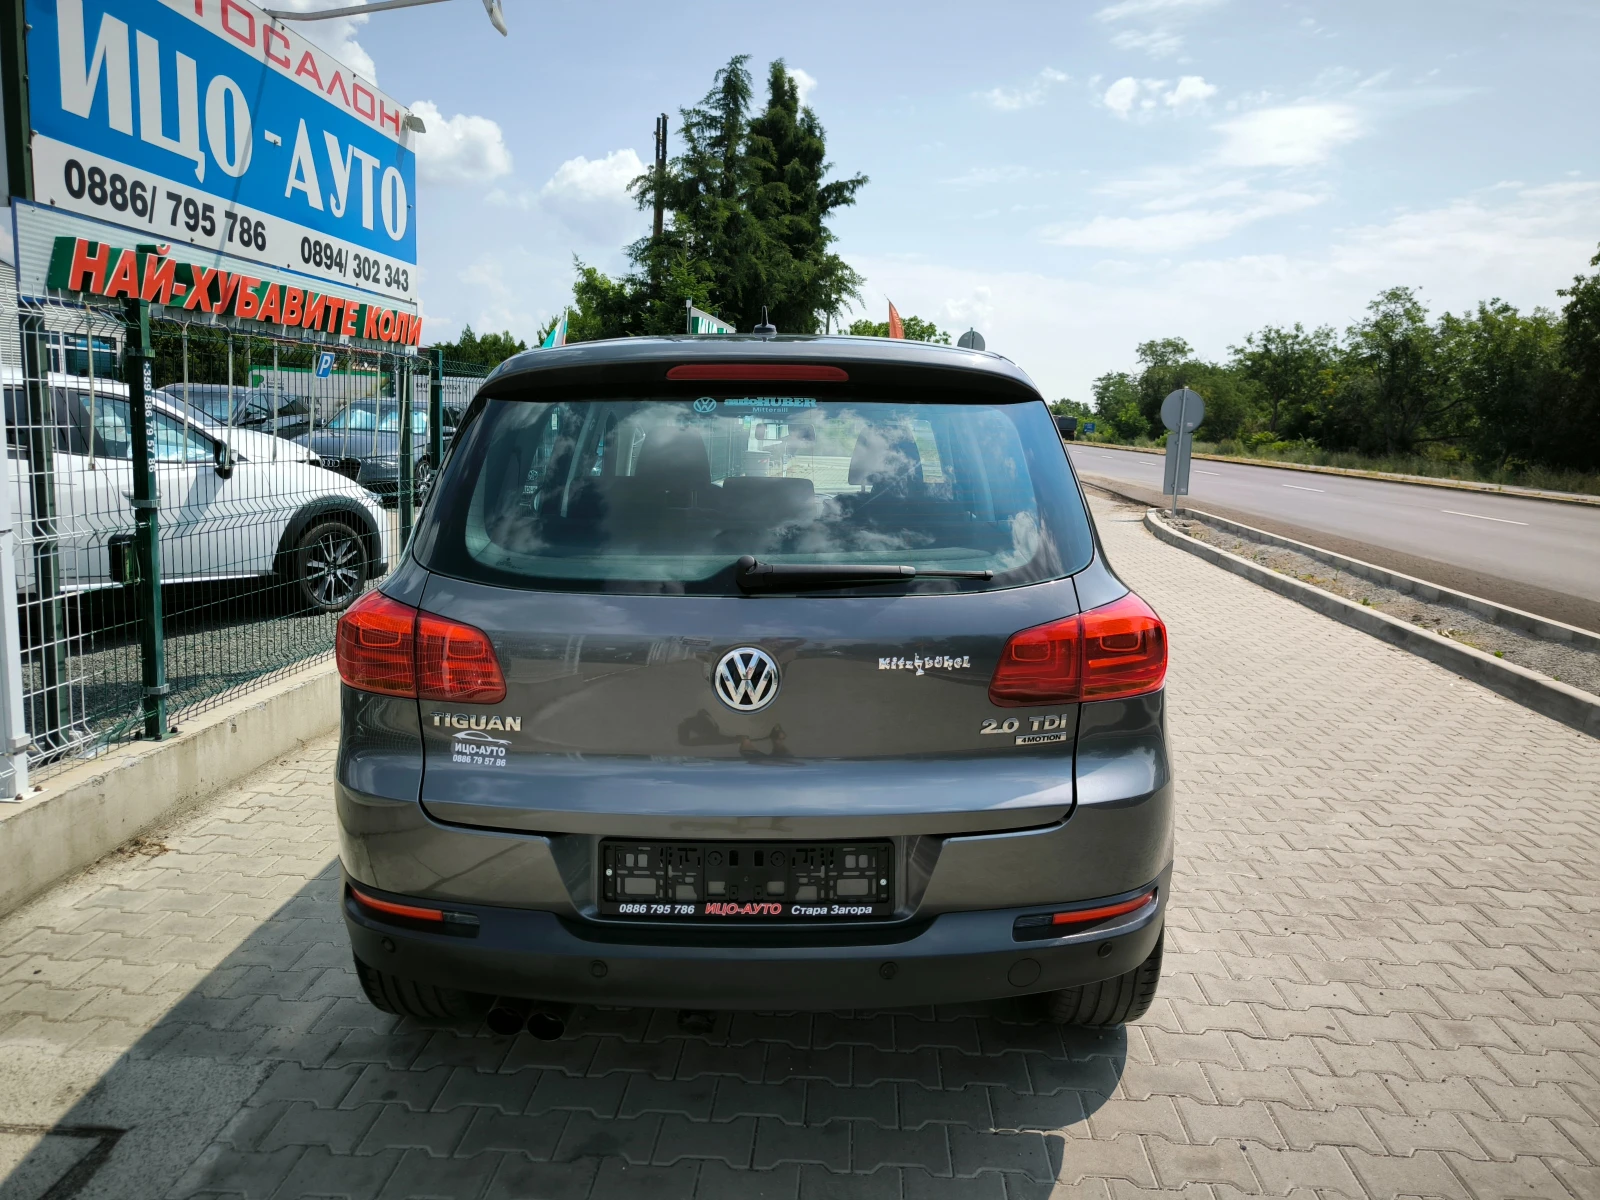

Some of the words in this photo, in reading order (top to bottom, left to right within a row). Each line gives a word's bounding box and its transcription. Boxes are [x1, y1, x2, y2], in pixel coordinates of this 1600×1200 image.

[64, 159, 157, 224] 0886/
[165, 191, 216, 237] 795
[223, 210, 267, 252] 786
[300, 236, 348, 278] 0894/
[352, 262, 381, 284] 302
[384, 267, 410, 293] 343
[68, 237, 359, 338] НАЙ-ХУБАВИТЕ
[364, 305, 423, 347] КОЛИ
[143, 360, 152, 391] +359
[144, 395, 153, 417] 886
[145, 420, 154, 436] 79
[146, 441, 155, 454] 57
[148, 457, 156, 473] 86
[430, 711, 522, 732] TIGUAN
[1029, 713, 1068, 731] TDI
[1021, 734, 1061, 744] 4MOTION
[454, 742, 506, 757] ИЦО-АУТО
[452, 754, 471, 763] 0886
[473, 756, 482, 764] 79
[484, 757, 494, 766] 57
[495, 758, 506, 767] 86
[619, 903, 647, 914] 0886
[650, 904, 671, 914] 795
[674, 905, 695, 915] 786
[704, 902, 782, 916] ИЦО-АУТО
[791, 904, 828, 916] Стара
[830, 904, 873, 915] Загора
